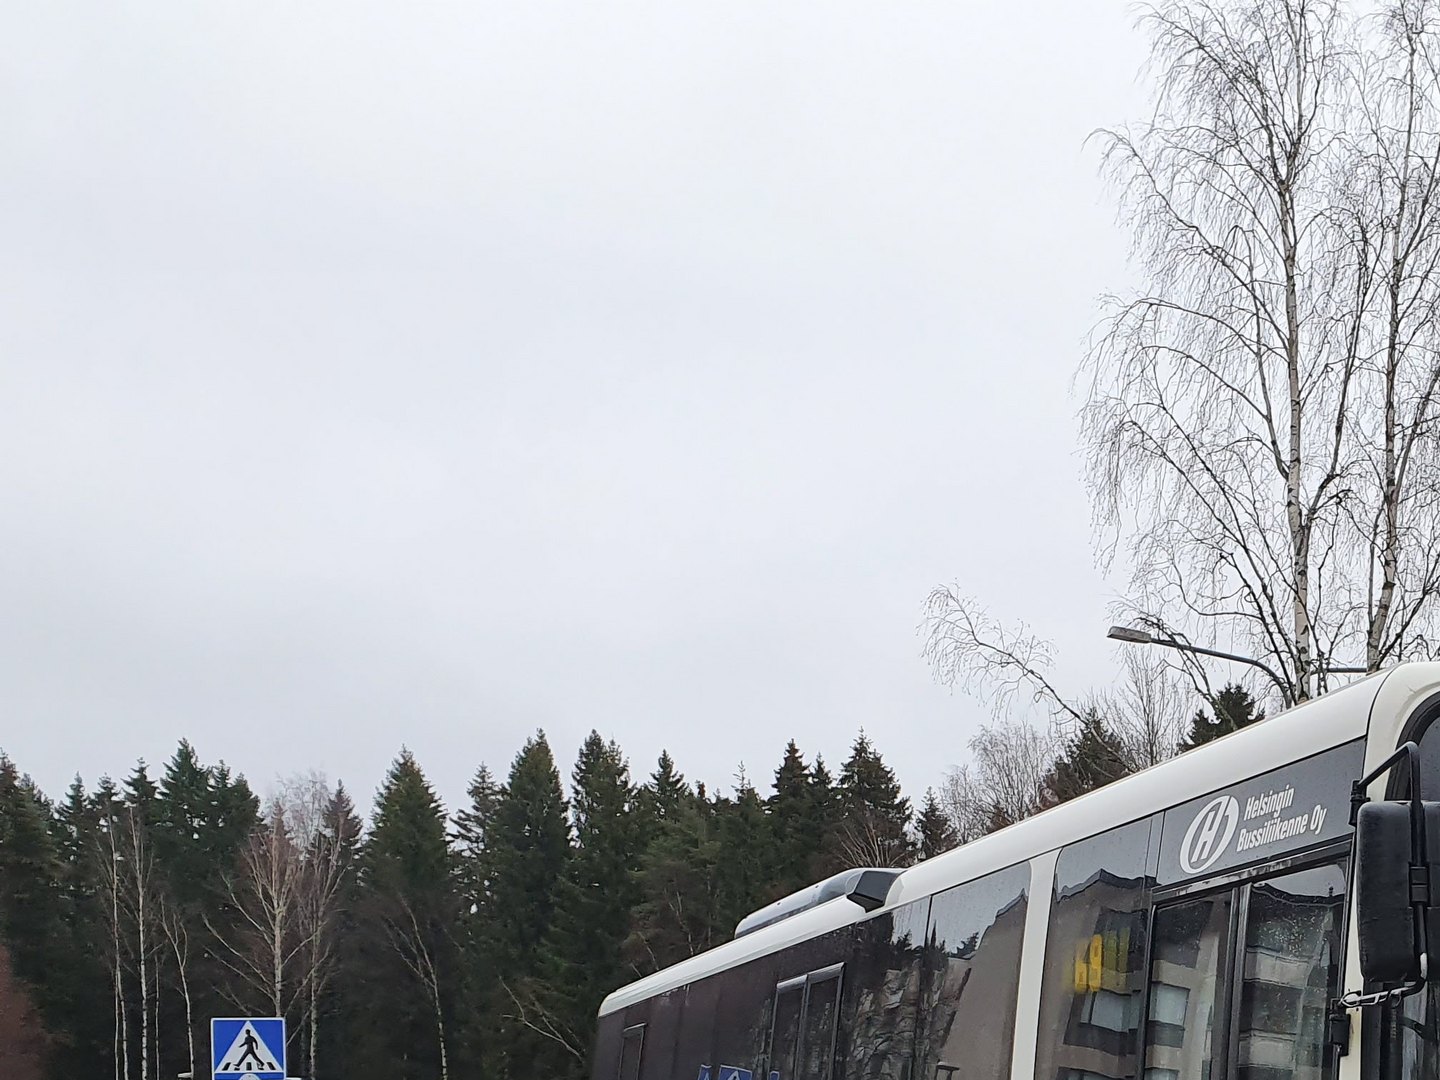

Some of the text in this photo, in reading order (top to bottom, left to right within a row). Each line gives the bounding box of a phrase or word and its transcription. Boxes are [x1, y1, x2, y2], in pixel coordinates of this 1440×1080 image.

[1243, 784, 1295, 821] Helsingin
[1236, 804, 1327, 852] Bussiliikenne Oy
